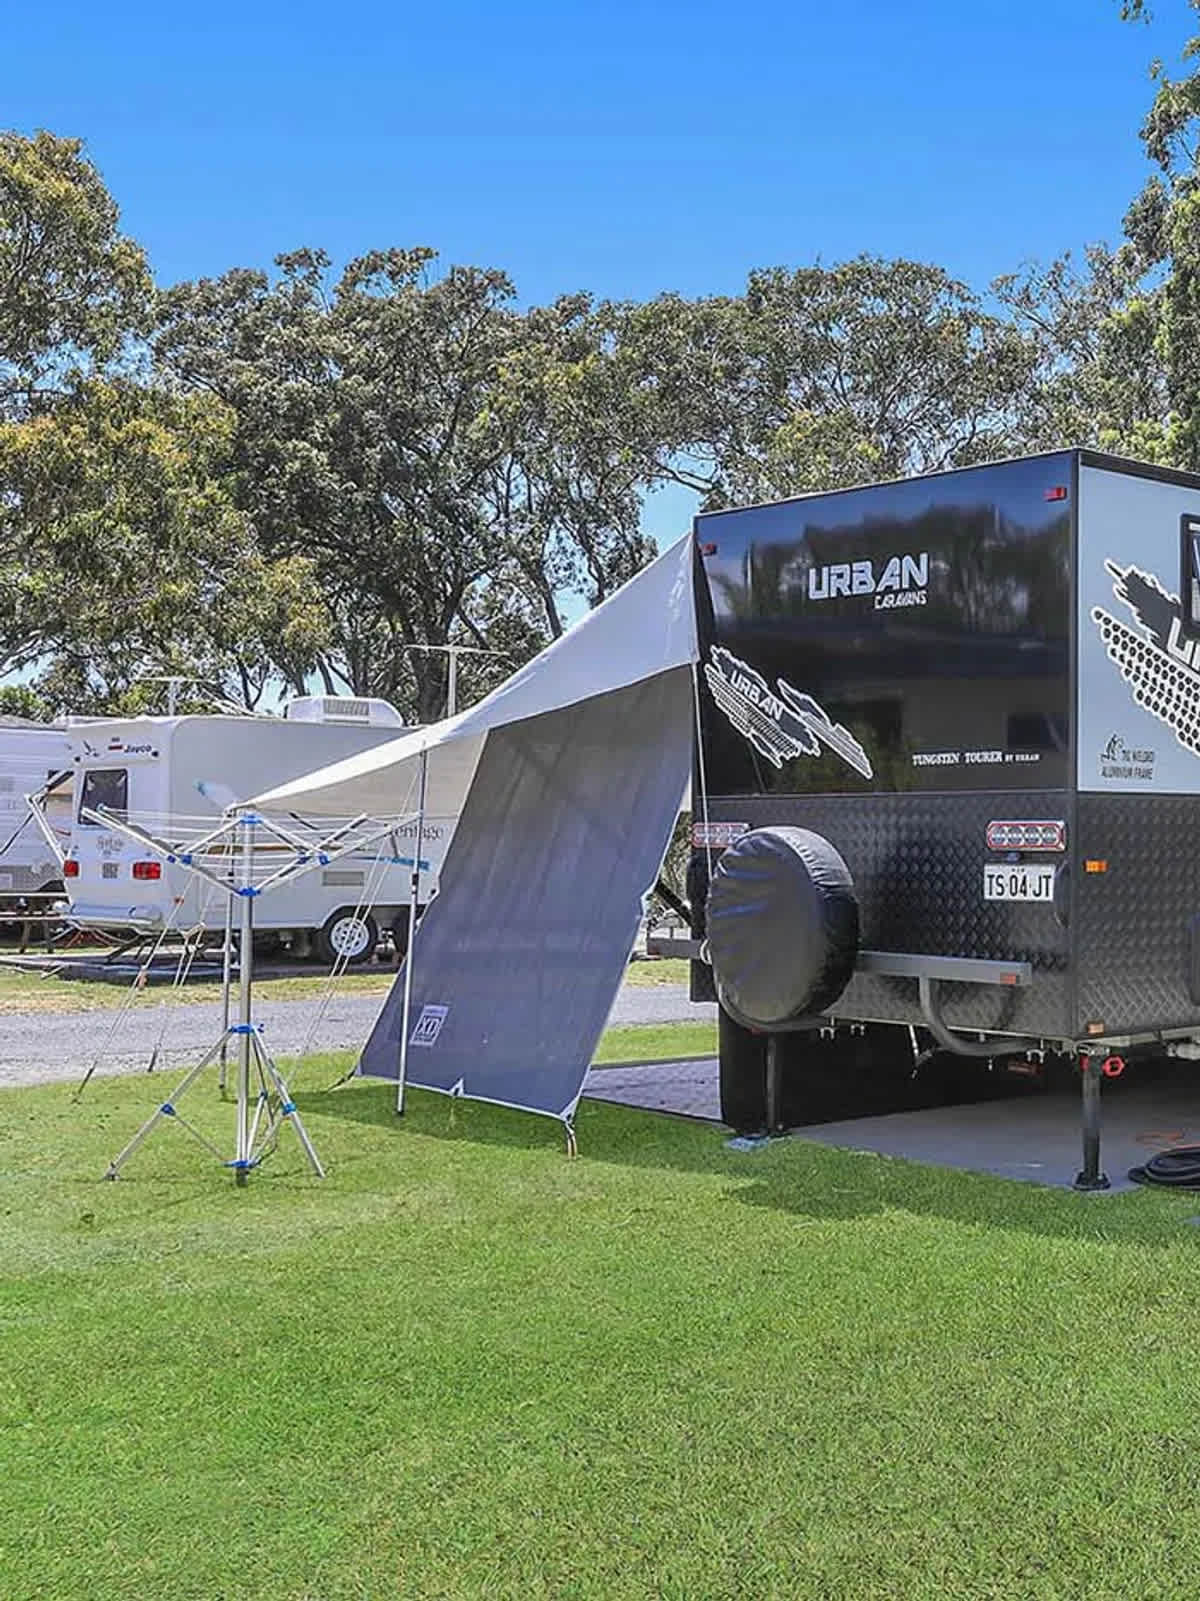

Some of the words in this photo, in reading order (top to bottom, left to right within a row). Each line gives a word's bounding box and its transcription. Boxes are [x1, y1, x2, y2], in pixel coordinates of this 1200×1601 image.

[809, 552, 928, 599] URBAN
[874, 590, 928, 609] CARAVANS
[731, 669, 785, 720] URBAN
[912, 752, 960, 766] TUNGSTEN
[964, 751, 1002, 764] TOURER
